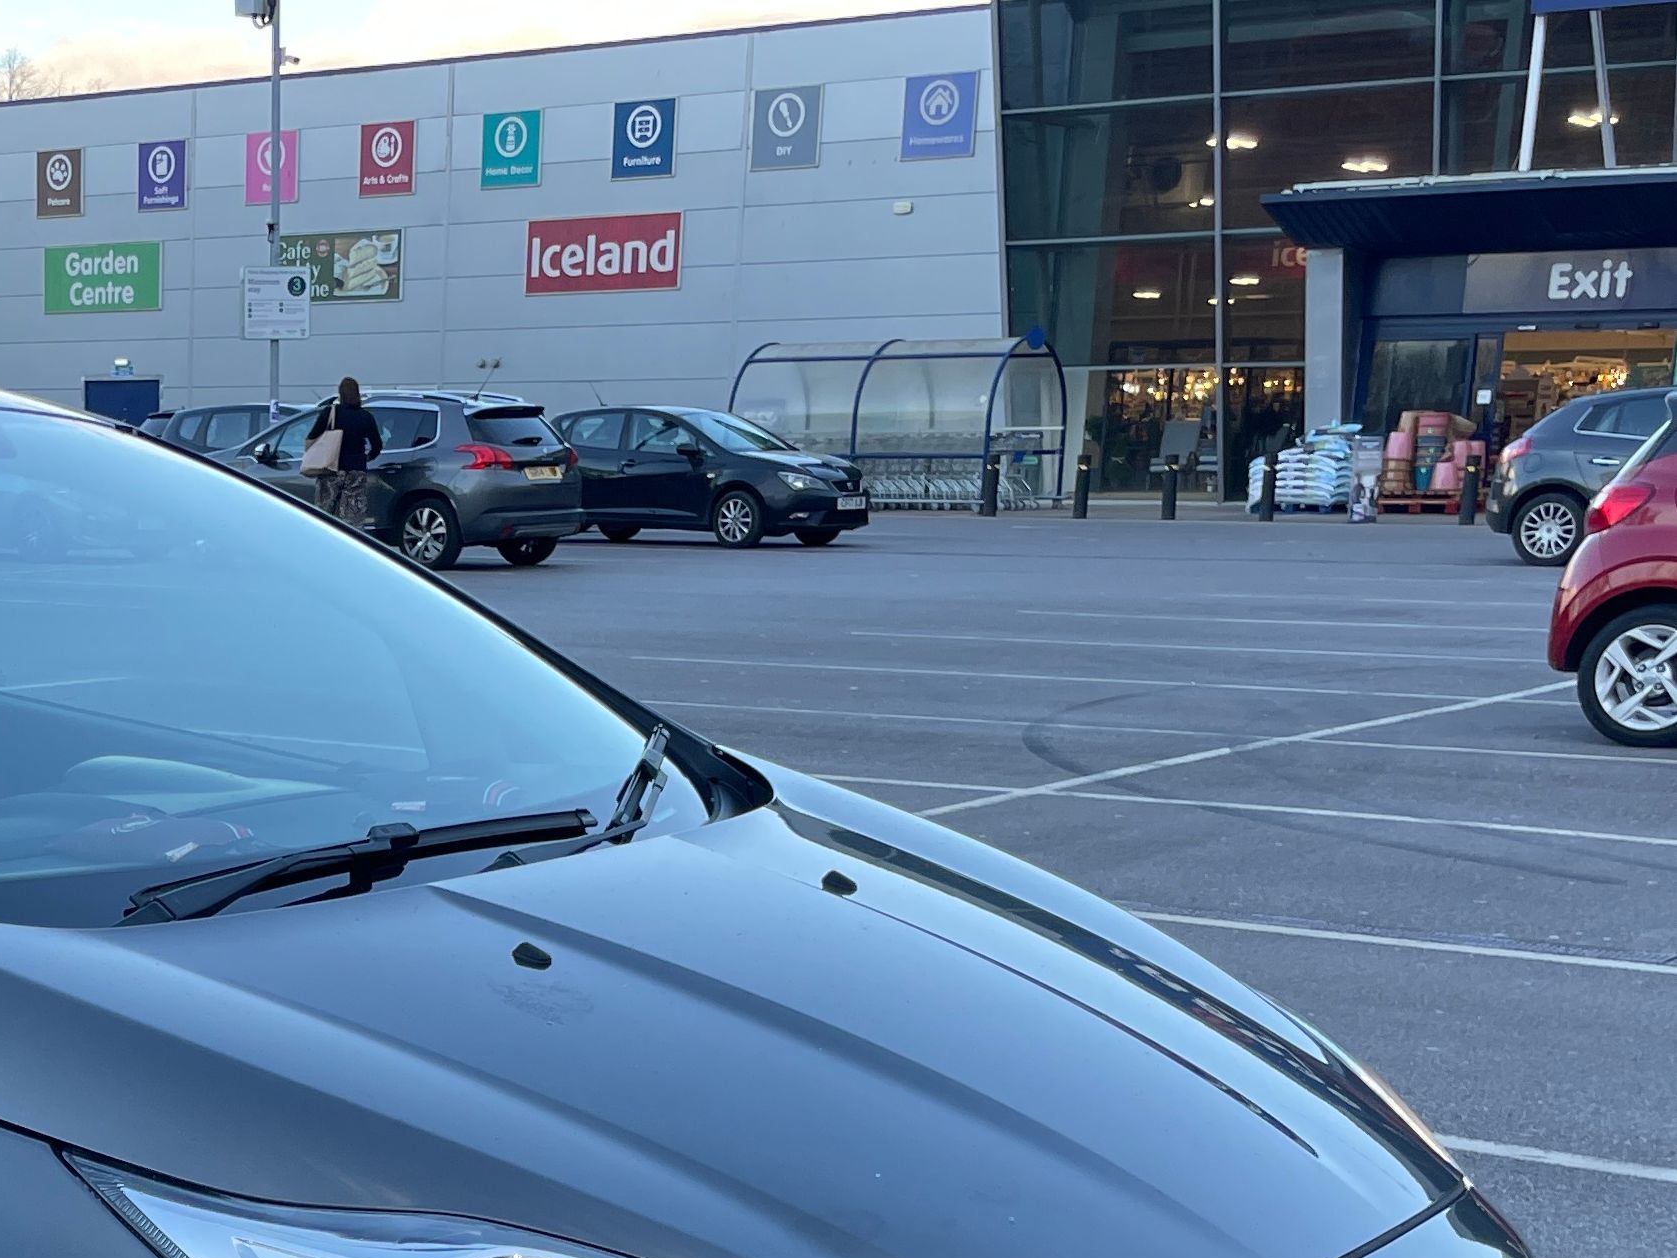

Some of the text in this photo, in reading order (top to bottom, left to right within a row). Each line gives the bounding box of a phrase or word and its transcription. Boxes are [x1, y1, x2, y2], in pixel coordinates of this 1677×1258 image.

[775, 146, 792, 156] DIY
[623, 156, 662, 168] Furniture
[485, 165, 533, 176] Home Decor
[363, 176, 378, 185] Arts
[386, 173, 409, 184] Crafts
[279, 240, 311, 260] Cafe
[530, 229, 676, 278] Iceland
[65, 249, 139, 277] Garden
[292, 278, 302, 291] 3
[1547, 258, 1633, 300] Exit
[69, 281, 135, 306] Centre
[311, 284, 330, 298] ne
